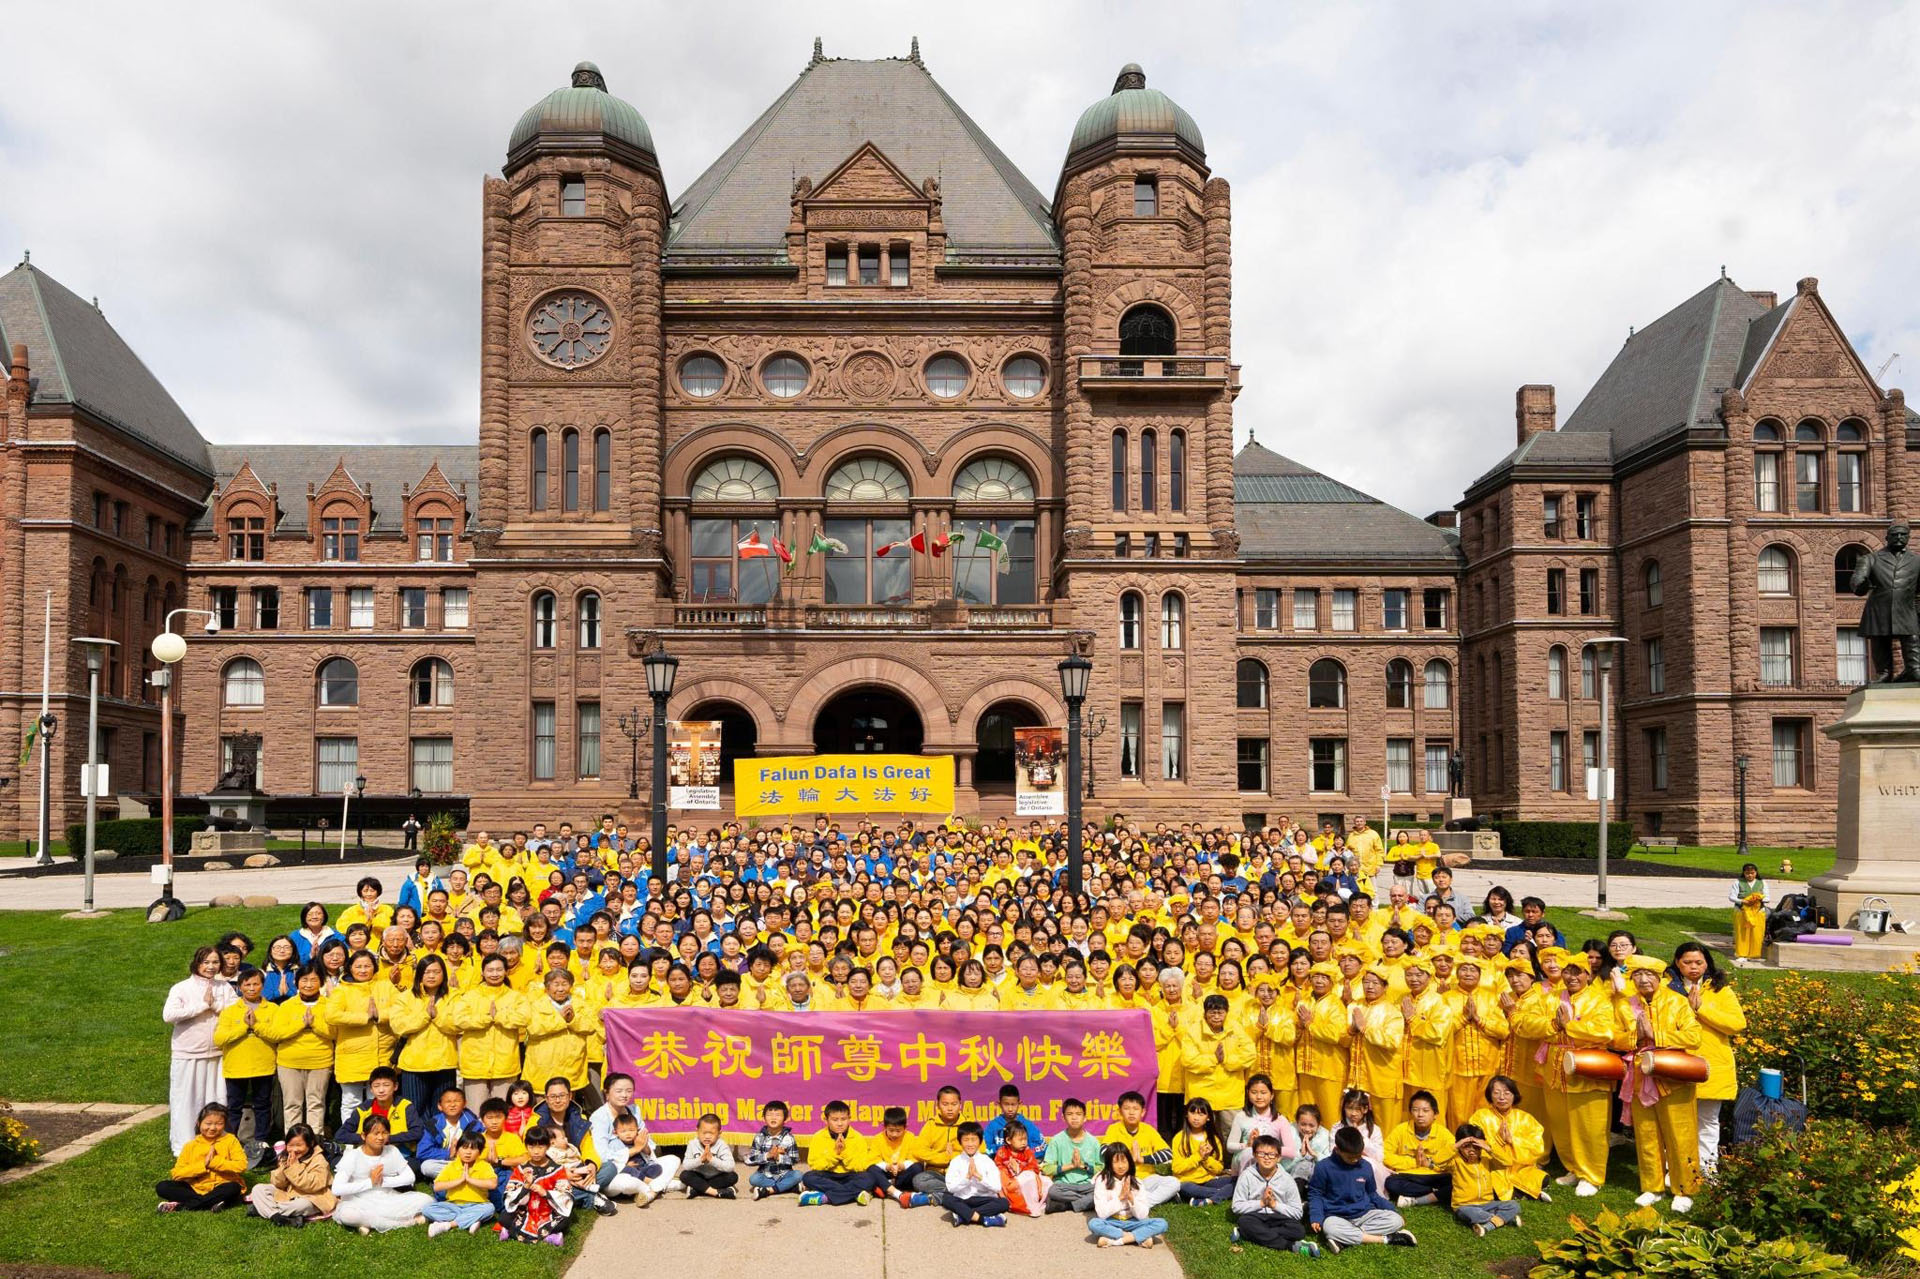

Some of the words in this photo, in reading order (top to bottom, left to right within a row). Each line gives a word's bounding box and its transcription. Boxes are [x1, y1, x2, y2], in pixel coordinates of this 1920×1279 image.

[760, 767, 809, 782] Falun
[814, 765, 857, 779] Dafa
[862, 766, 878, 779] Is
[883, 765, 931, 779] Great
[759, 787, 932, 804] 法輪大法好
[634, 1031, 1132, 1083] 恭祝師尊中秋快樂
[634, 1097, 730, 1125] Wishing
[736, 1097, 813, 1121] Maer
[1049, 1098, 1124, 1121] Ftiva
